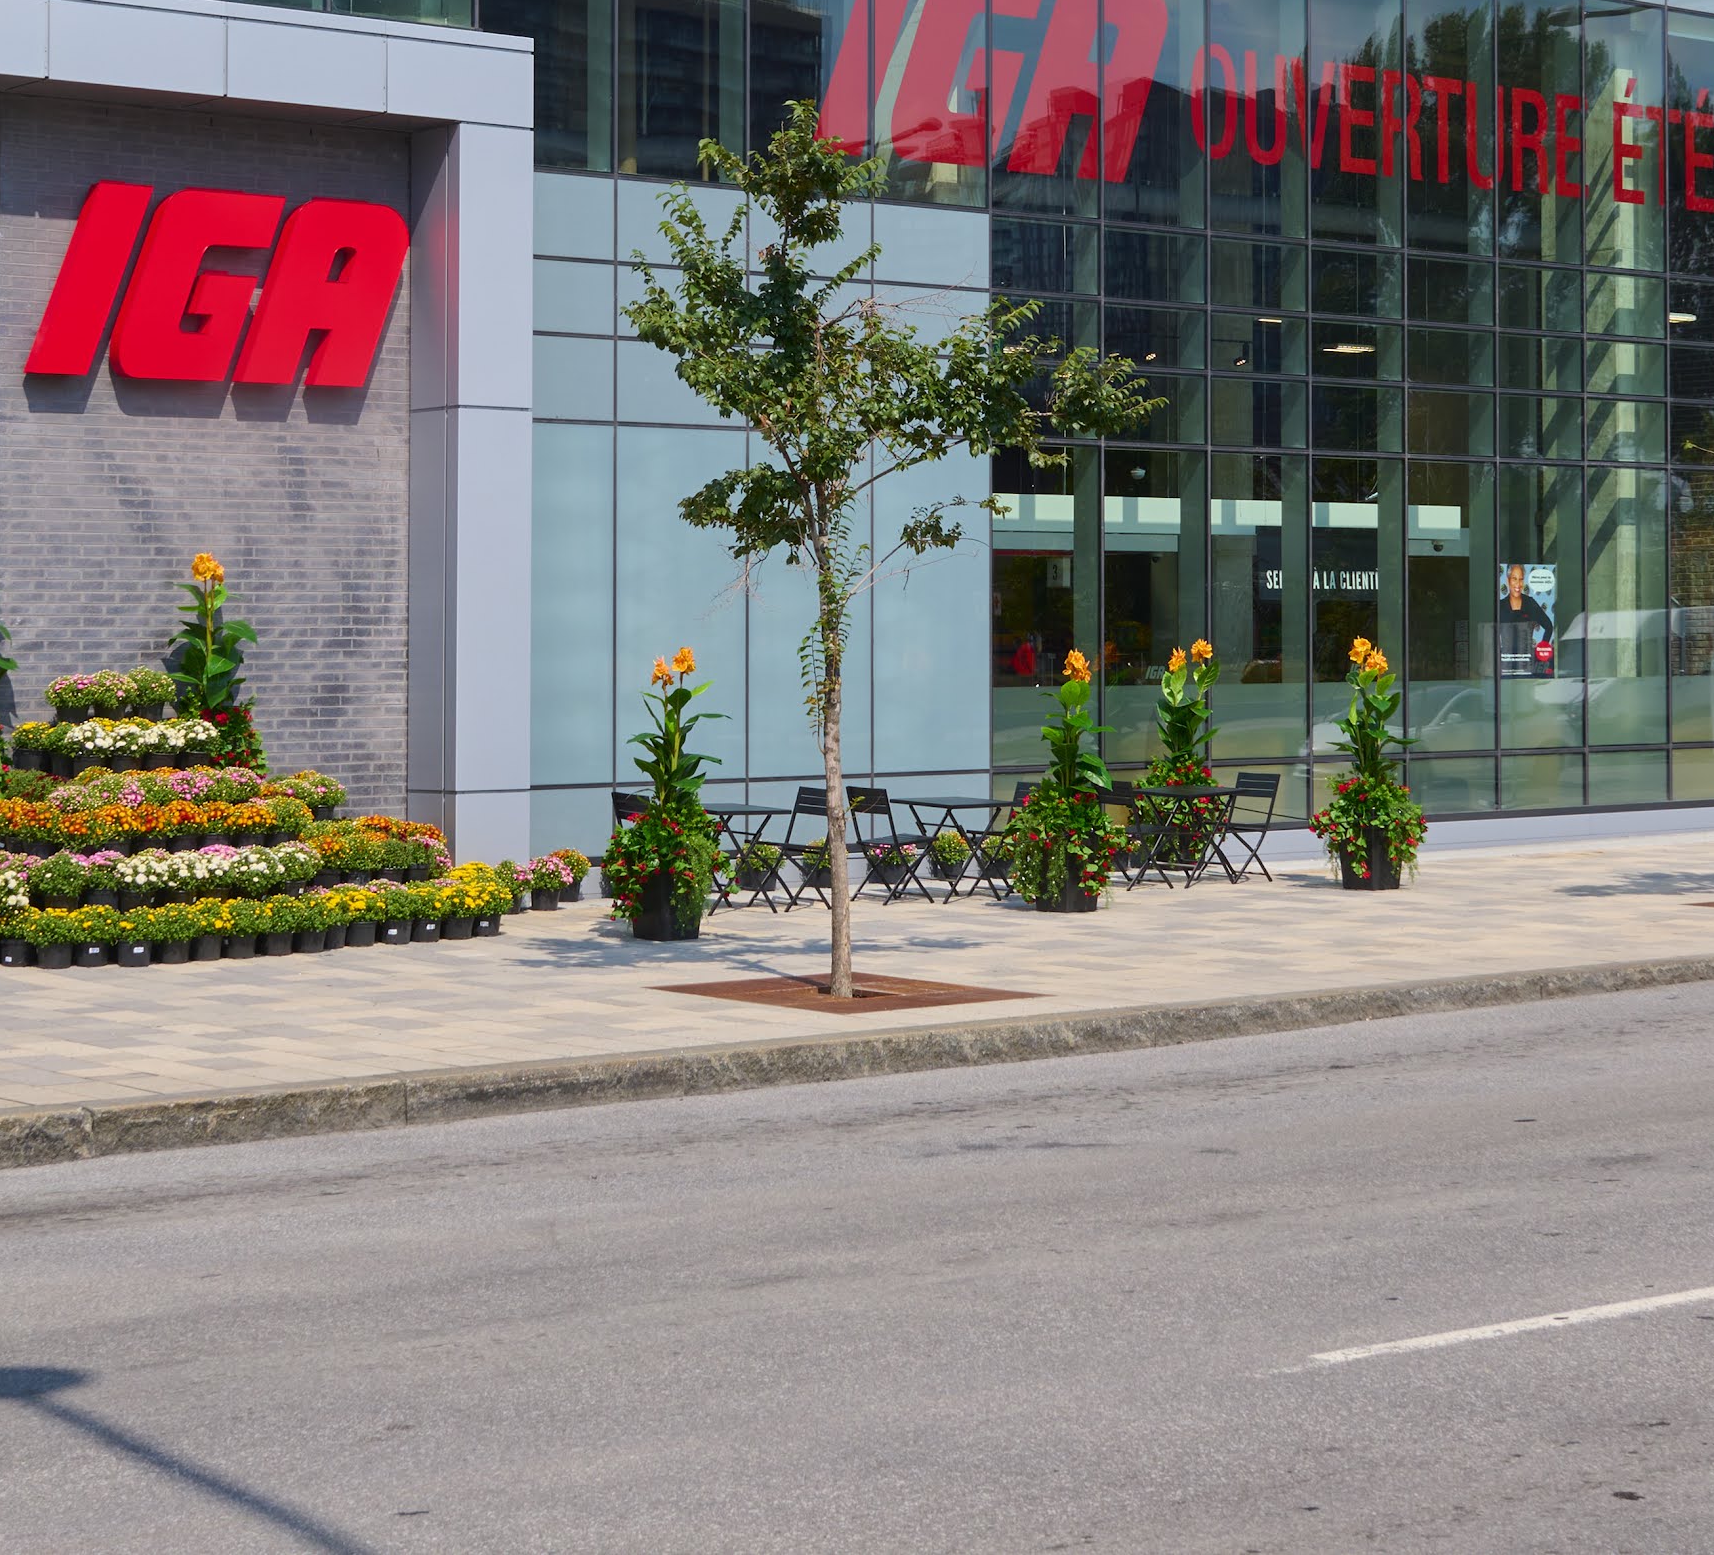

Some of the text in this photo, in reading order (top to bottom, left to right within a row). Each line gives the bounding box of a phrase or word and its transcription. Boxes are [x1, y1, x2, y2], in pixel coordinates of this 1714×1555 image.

[1189, 42, 1590, 201] OUVERTURE
[23, 179, 410, 388] IGA
[1323, 571, 1336, 590] LA
